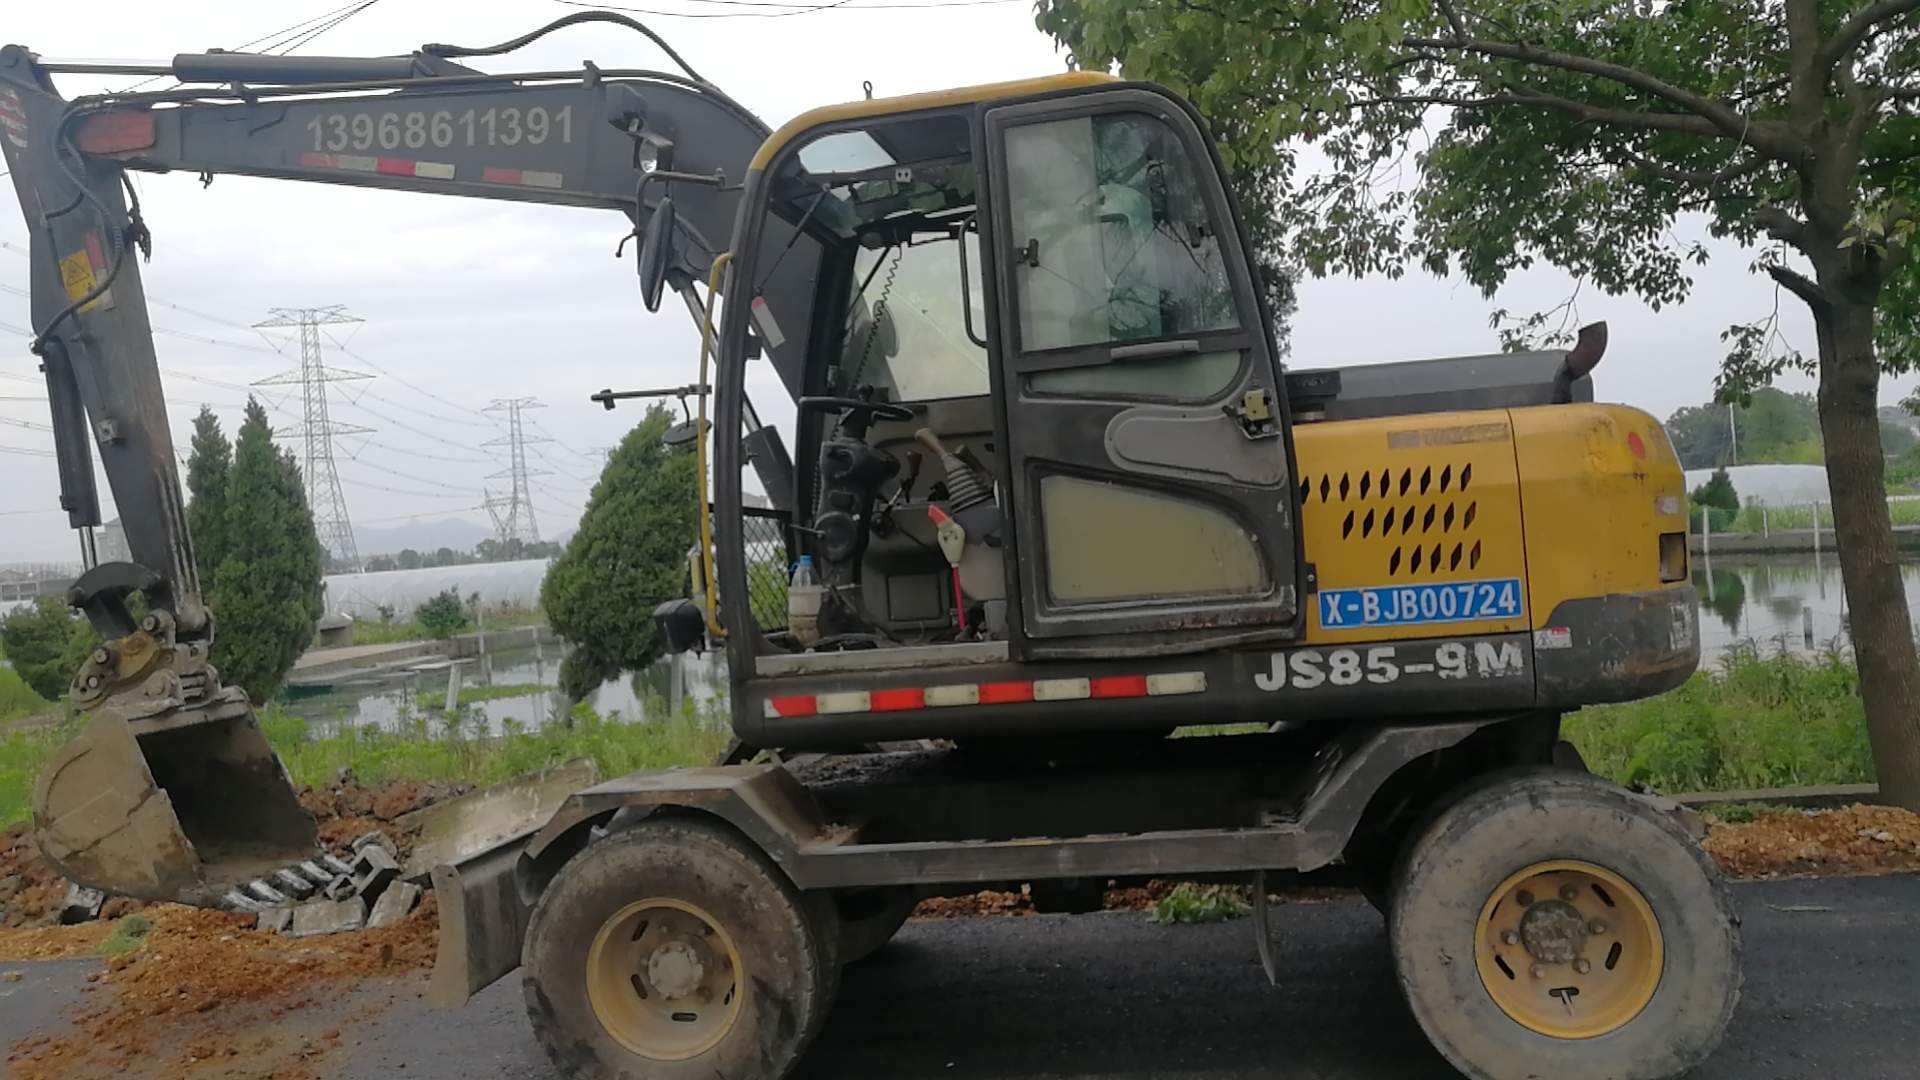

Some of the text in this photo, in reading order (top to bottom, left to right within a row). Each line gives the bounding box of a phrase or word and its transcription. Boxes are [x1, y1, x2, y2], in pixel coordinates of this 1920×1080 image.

[307, 105, 572, 151] 13968611391
[1326, 583, 1516, 624] X-BJB00724
[1254, 642, 1524, 692] JS85-9M
